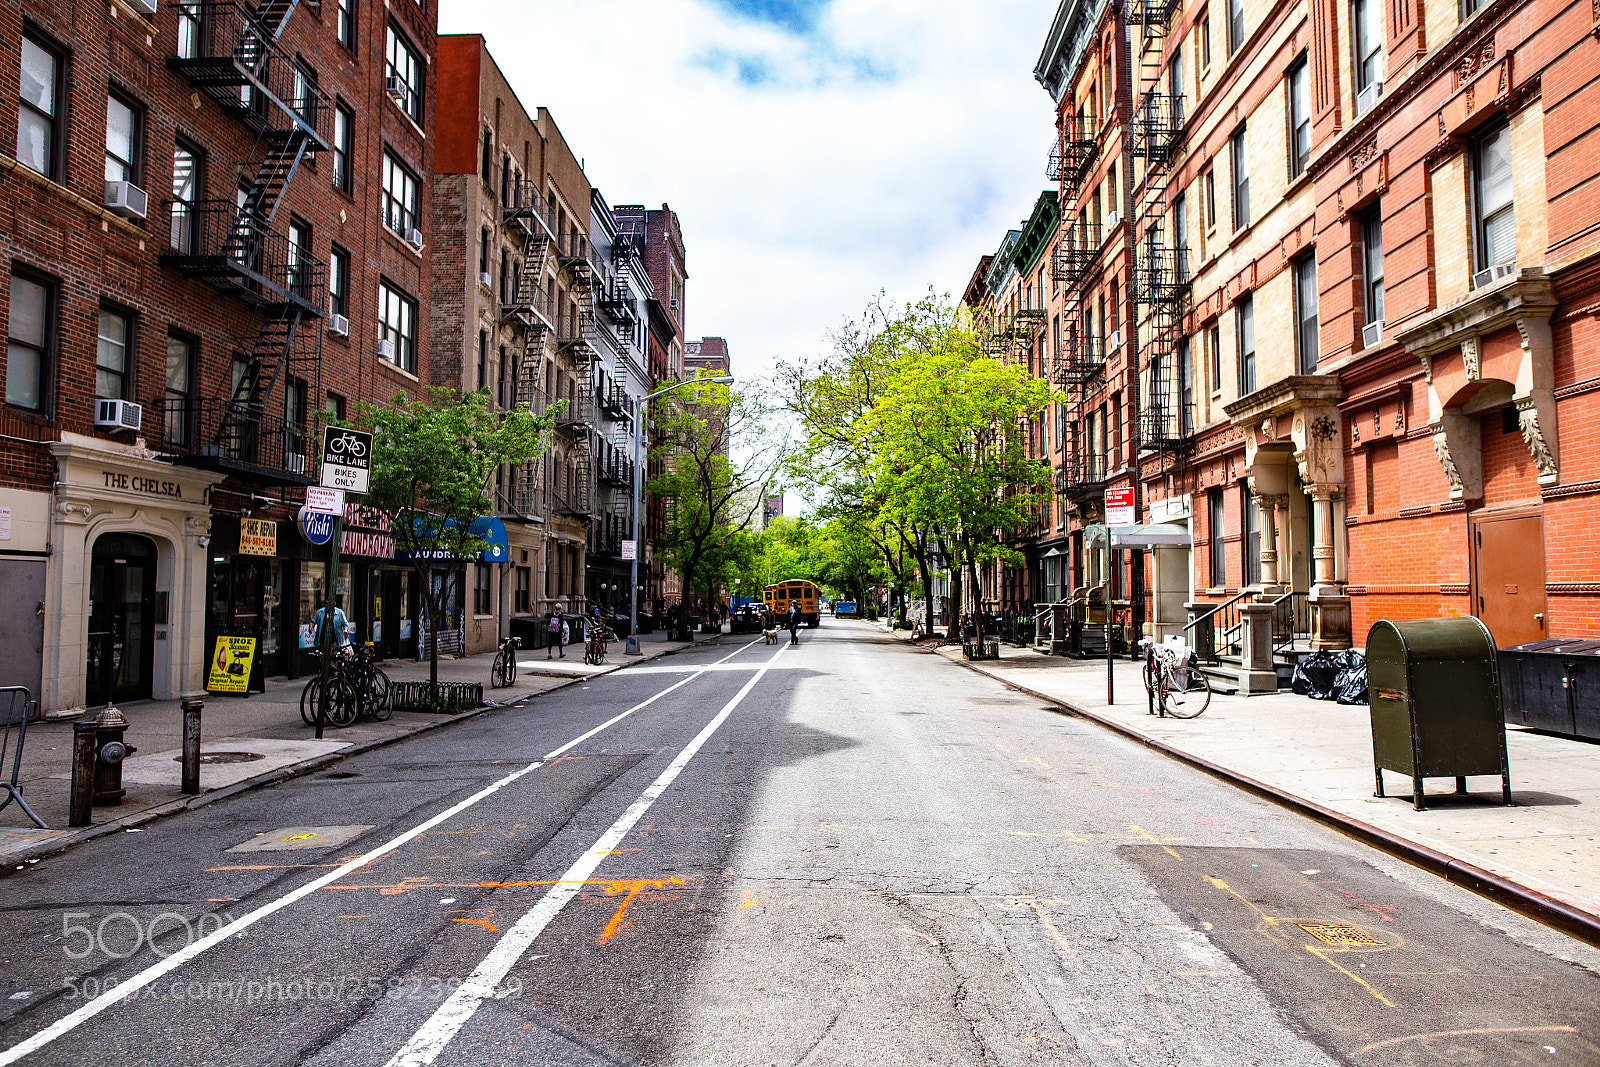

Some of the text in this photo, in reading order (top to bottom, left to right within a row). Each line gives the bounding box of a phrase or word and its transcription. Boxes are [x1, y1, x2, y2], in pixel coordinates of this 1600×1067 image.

[326, 453, 368, 468] BIKE LANE
[335, 468, 357, 478] BIKES
[102, 471, 182, 497] THE CHELSEA
[334, 477, 356, 487] ONLY
[316, 489, 336, 497] PARKING
[345, 503, 392, 532] CLEERS
[247, 519, 259, 536] SHOE
[260, 521, 276, 537] REPAIR
[340, 530, 396, 559] AUNDROMAT
[408, 550, 482, 559] AUNDRAT
